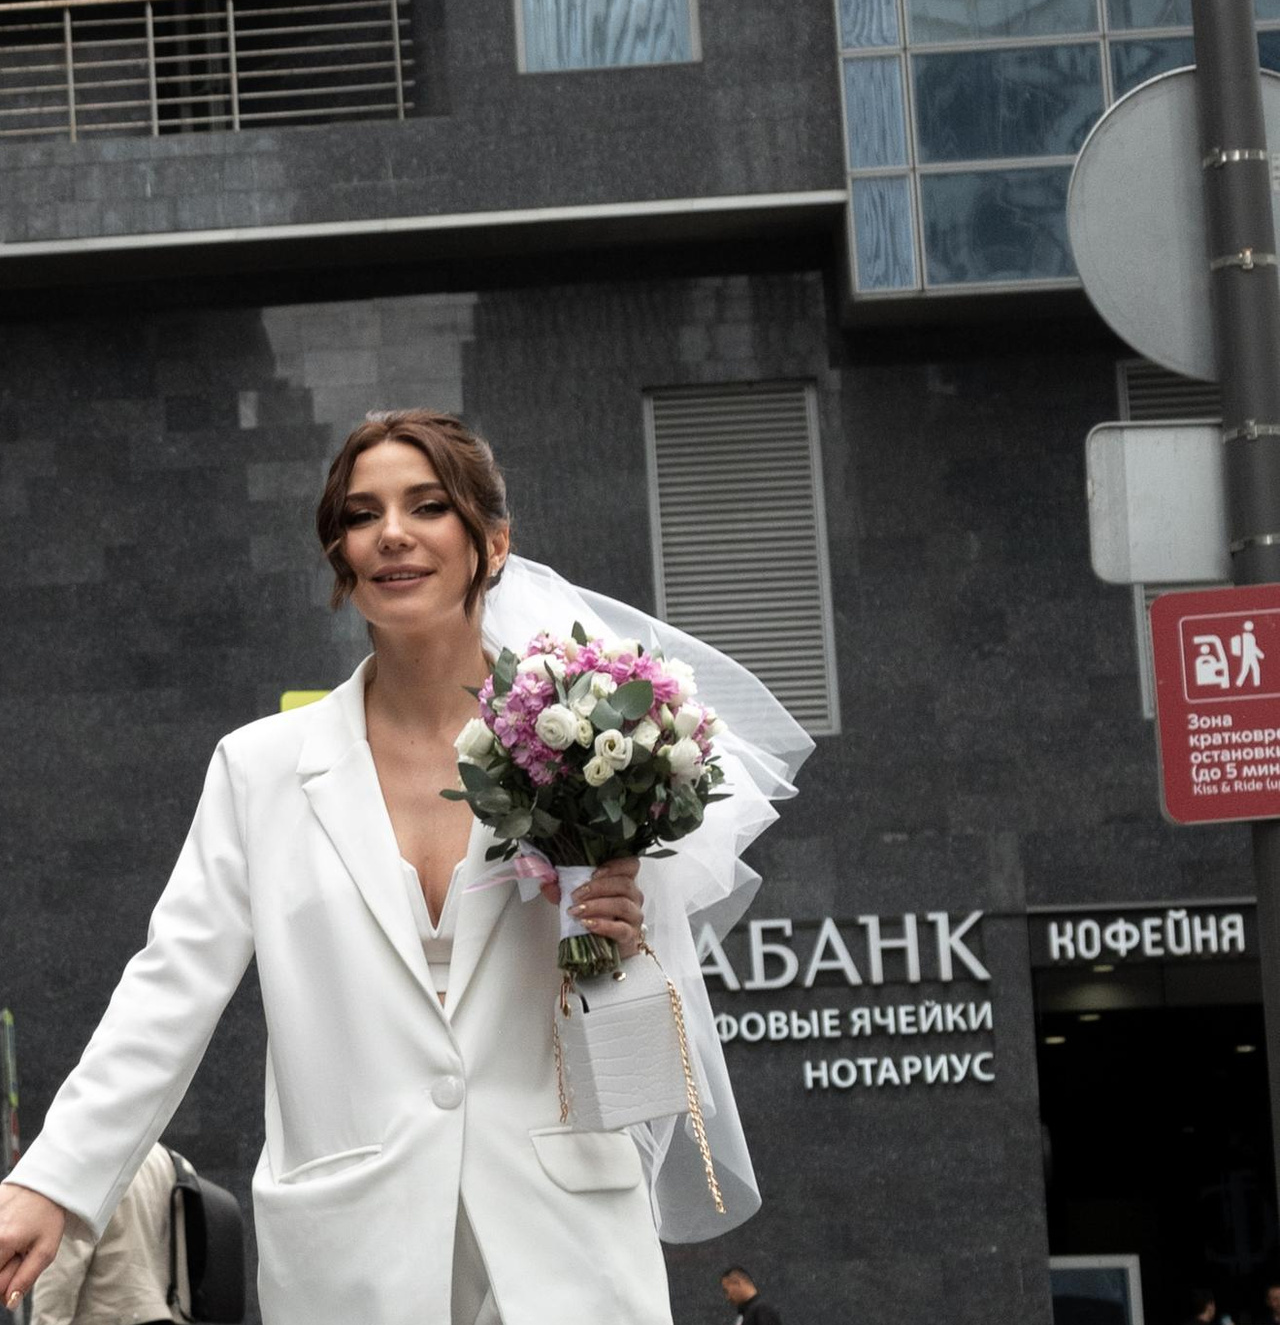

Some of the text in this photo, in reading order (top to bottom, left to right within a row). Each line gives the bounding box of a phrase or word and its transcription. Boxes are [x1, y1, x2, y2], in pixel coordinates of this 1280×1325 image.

[1187, 713, 1233, 730] Зона
[1191, 762, 1280, 783] (до 5 мин
[1193, 777, 1280, 795] Kiss & Ride (u
[1048, 907, 1246, 960] КОФЕЙНЯ
[714, 1000, 993, 1043] ФОВЫЕ ЯЧЕЙКИ
[803, 1052, 995, 1090] НОТАРИУС
